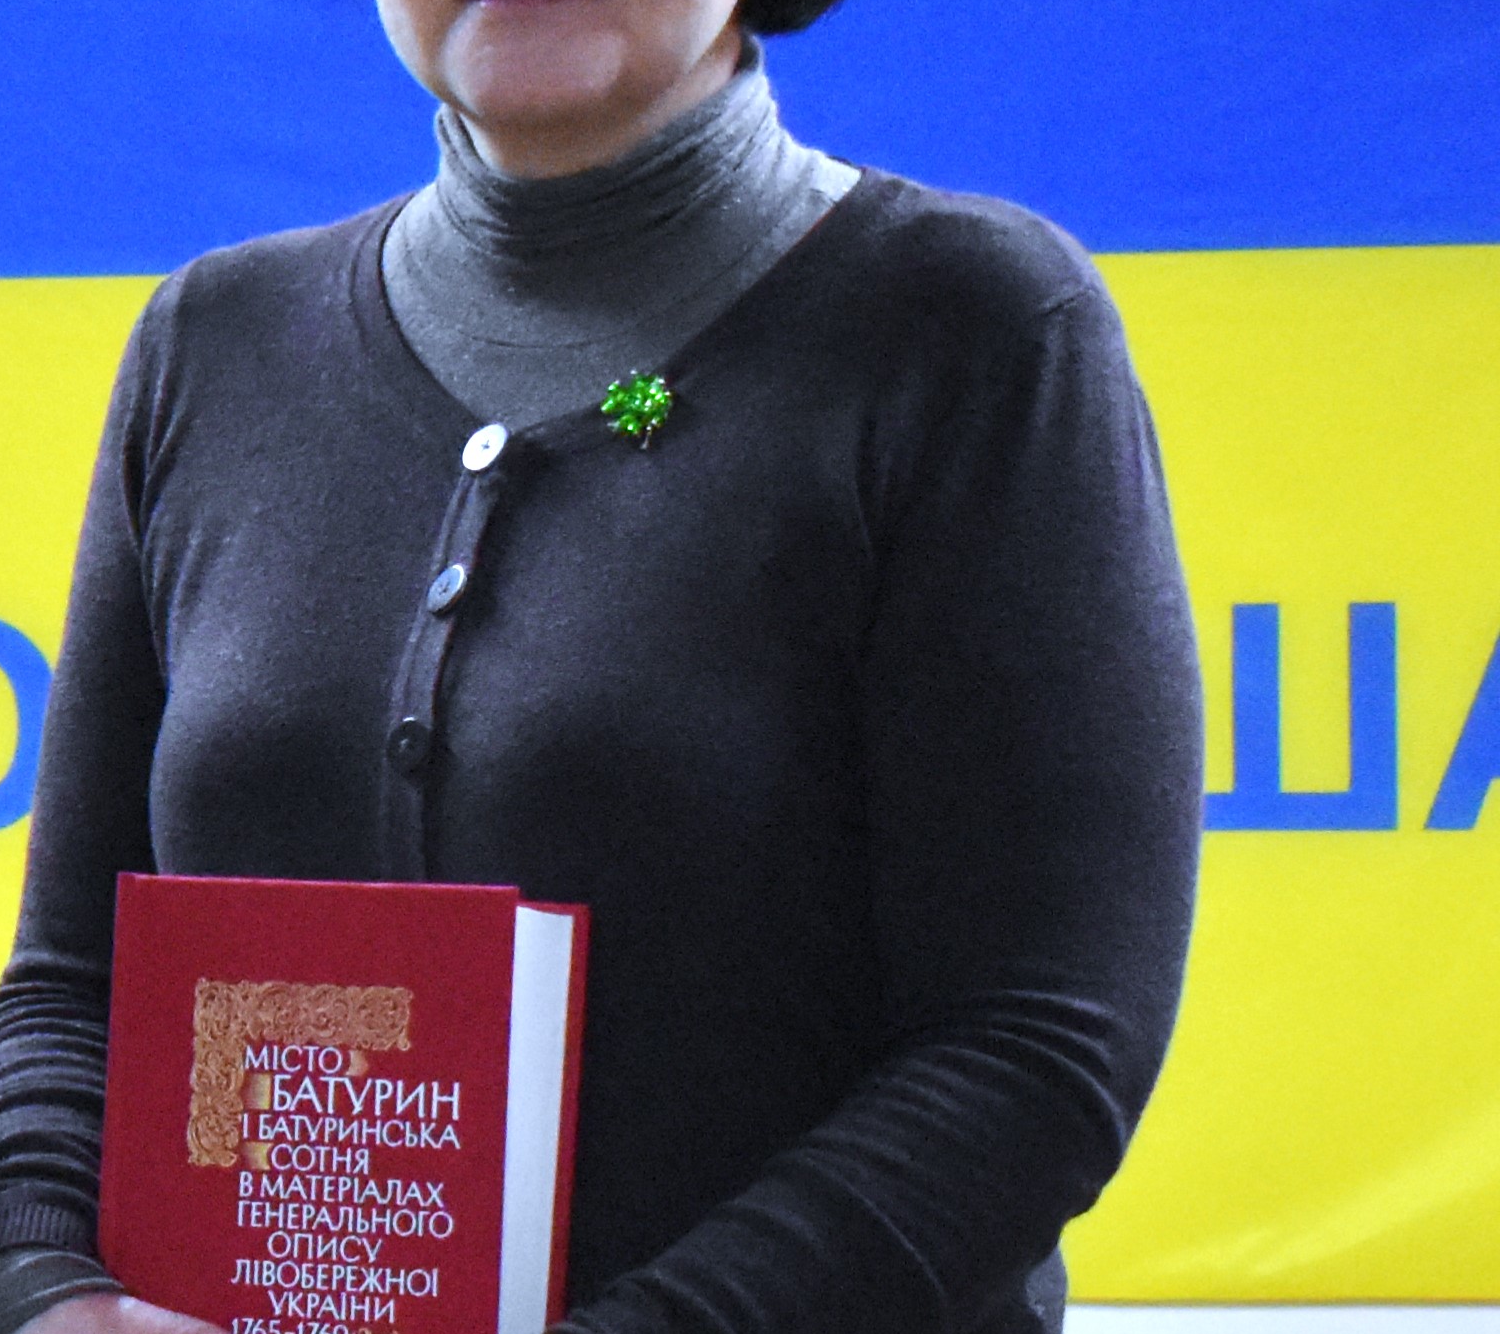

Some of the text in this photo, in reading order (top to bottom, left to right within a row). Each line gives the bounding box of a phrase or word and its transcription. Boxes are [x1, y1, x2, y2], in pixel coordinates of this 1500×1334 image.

[244, 1045, 343, 1074] МІСТО
[273, 1074, 460, 1121] БАТУРИН
[242, 1114, 461, 1149] І БАТУРИНСЬКА
[271, 1143, 370, 1175] СОТНЯ
[239, 1171, 444, 1208] В МАТЕРІАЛАХ
[237, 1201, 454, 1238] ГЕНЕРАЛЬНОГО
[267, 1231, 382, 1263] ОПИСУ
